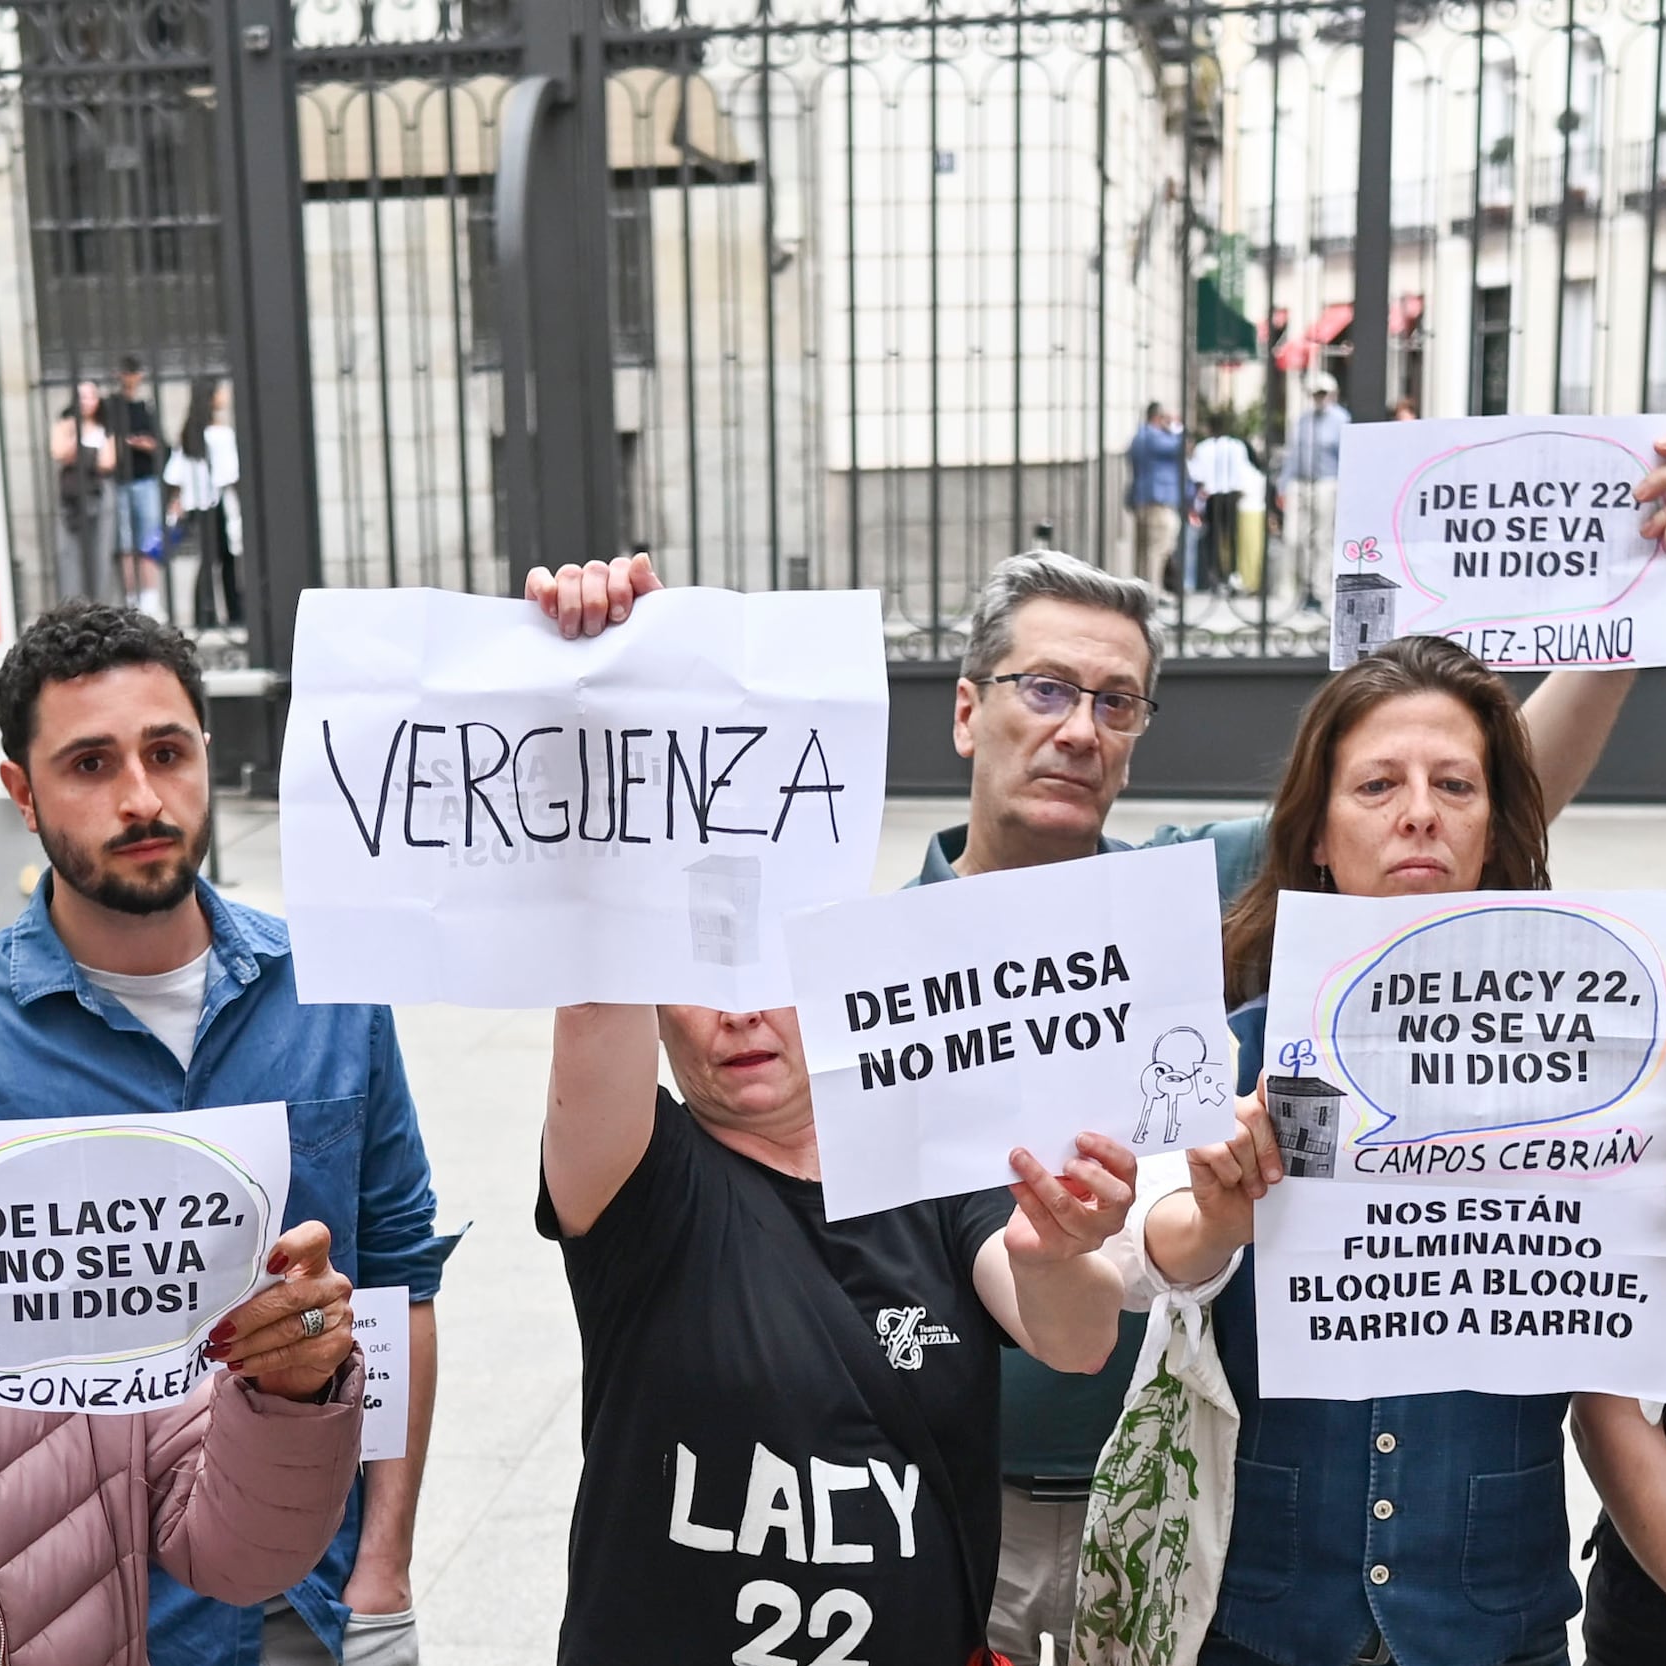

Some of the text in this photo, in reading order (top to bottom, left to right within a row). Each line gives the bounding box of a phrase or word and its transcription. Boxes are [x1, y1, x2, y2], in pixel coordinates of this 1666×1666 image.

[1420, 484, 1477, 516] ¡DE
[1489, 482, 1580, 508] LACY
[1445, 517, 1604, 542] NO SE VA
[1454, 551, 1597, 577] NI DIOS!
[323, 720, 844, 857] VERGUENZA
[845, 945, 1129, 1032] DE MI CASA
[1371, 970, 1640, 1012] ¡DE LACY 22,
[1398, 1012, 1595, 1043] NO SE VA
[859, 1003, 1130, 1090] NO ME VOY
[1412, 1050, 1587, 1084] NI DIOS!
[1355, 1129, 1653, 1175] CAMPOS CEBRIÁN
[49, 1197, 166, 1236] LACY
[179, 1193, 244, 1229] 22,
[1368, 1195, 1580, 1224] NOS ESTÁN
[77, 1244, 132, 1280] SE
[142, 1240, 205, 1275] VA
[1345, 1232, 1601, 1259] FULMINANDO
[13, 1282, 197, 1321] NI DIOS!
[1290, 1269, 1648, 1303] BLOQUE A BLOQUE,
[1310, 1308, 1632, 1341] BARRIO A BARRIO
[669, 1443, 919, 1564] LACY
